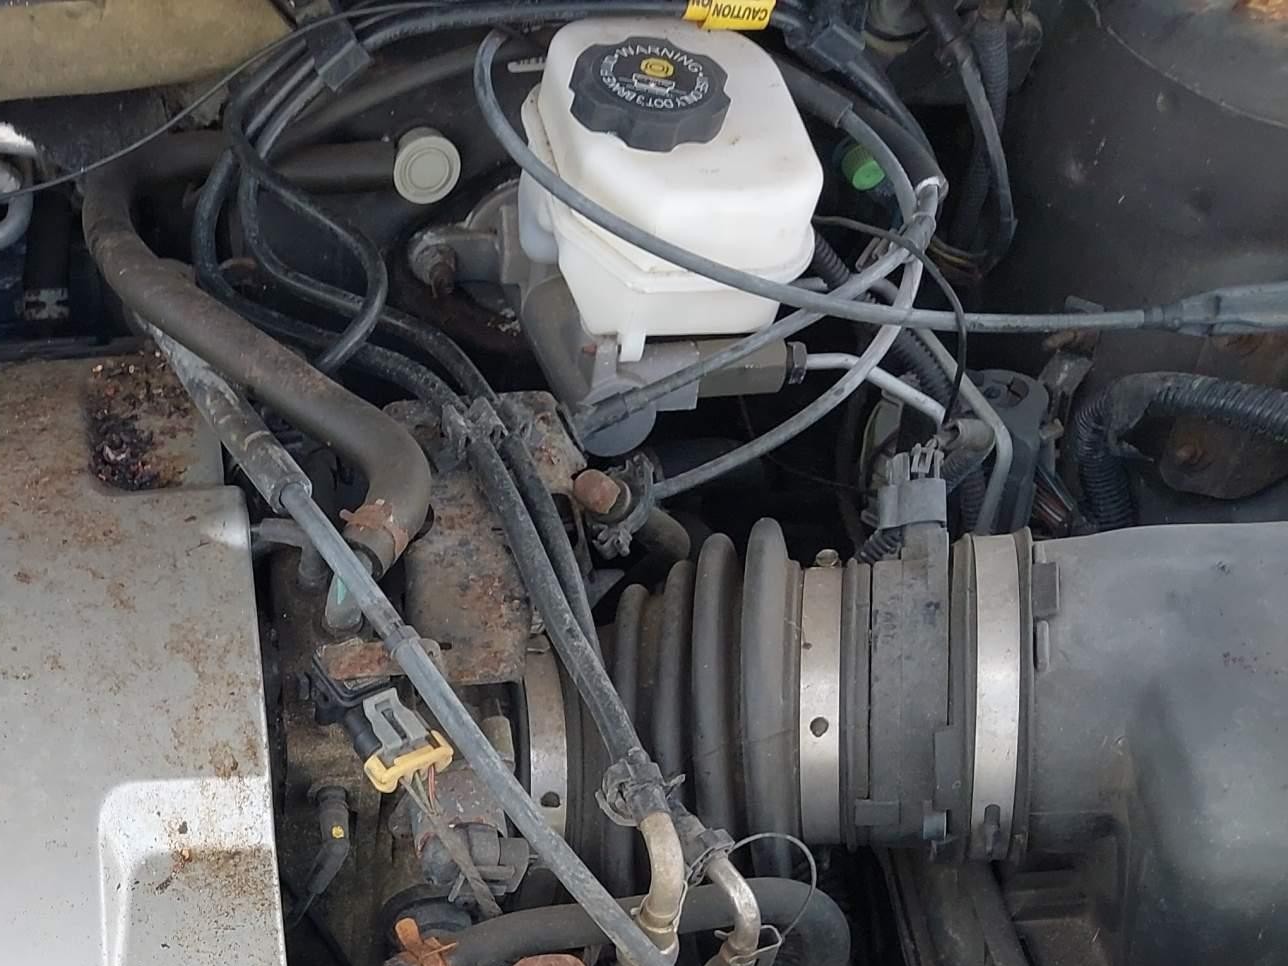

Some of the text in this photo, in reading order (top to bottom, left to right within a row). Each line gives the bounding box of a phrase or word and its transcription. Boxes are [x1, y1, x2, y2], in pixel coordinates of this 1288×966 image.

[711, 3, 769, 21] CAUTION
[616, 44, 703, 73] WARNING
[646, 97, 674, 109] DOT
